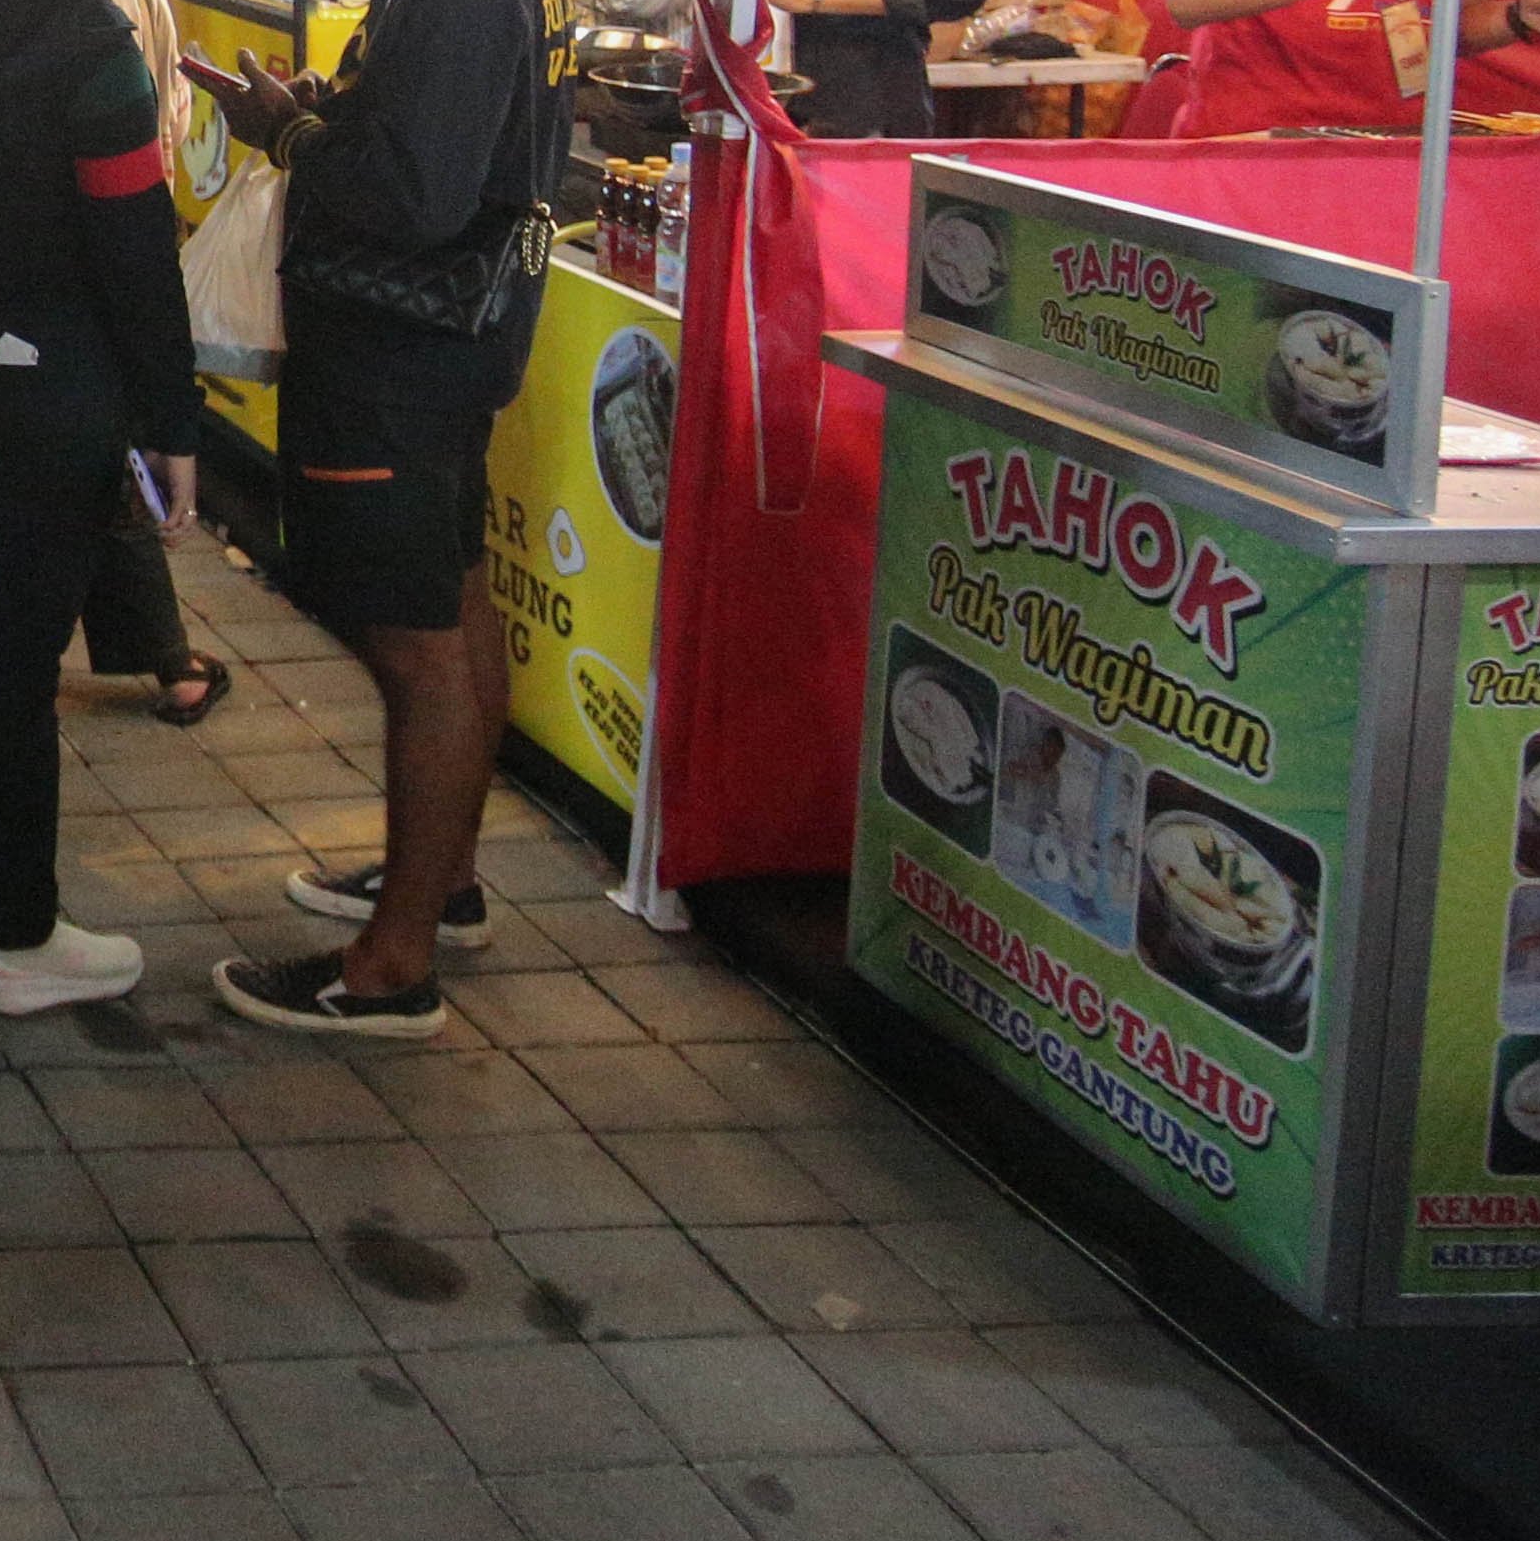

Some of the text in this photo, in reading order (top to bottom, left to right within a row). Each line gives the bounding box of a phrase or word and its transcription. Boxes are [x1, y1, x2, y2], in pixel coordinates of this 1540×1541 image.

[1040, 301, 1220, 396] Pak Wagiman
[1050, 240, 1220, 343] TAHOK
[489, 550, 573, 638] LUNG
[929, 544, 1277, 778] Pak Wagiman
[948, 450, 1265, 674] TAHOK
[890, 852, 1277, 1146] KEMBANG TAHU
[907, 936, 1238, 1196] KRETEG GANTUNG
